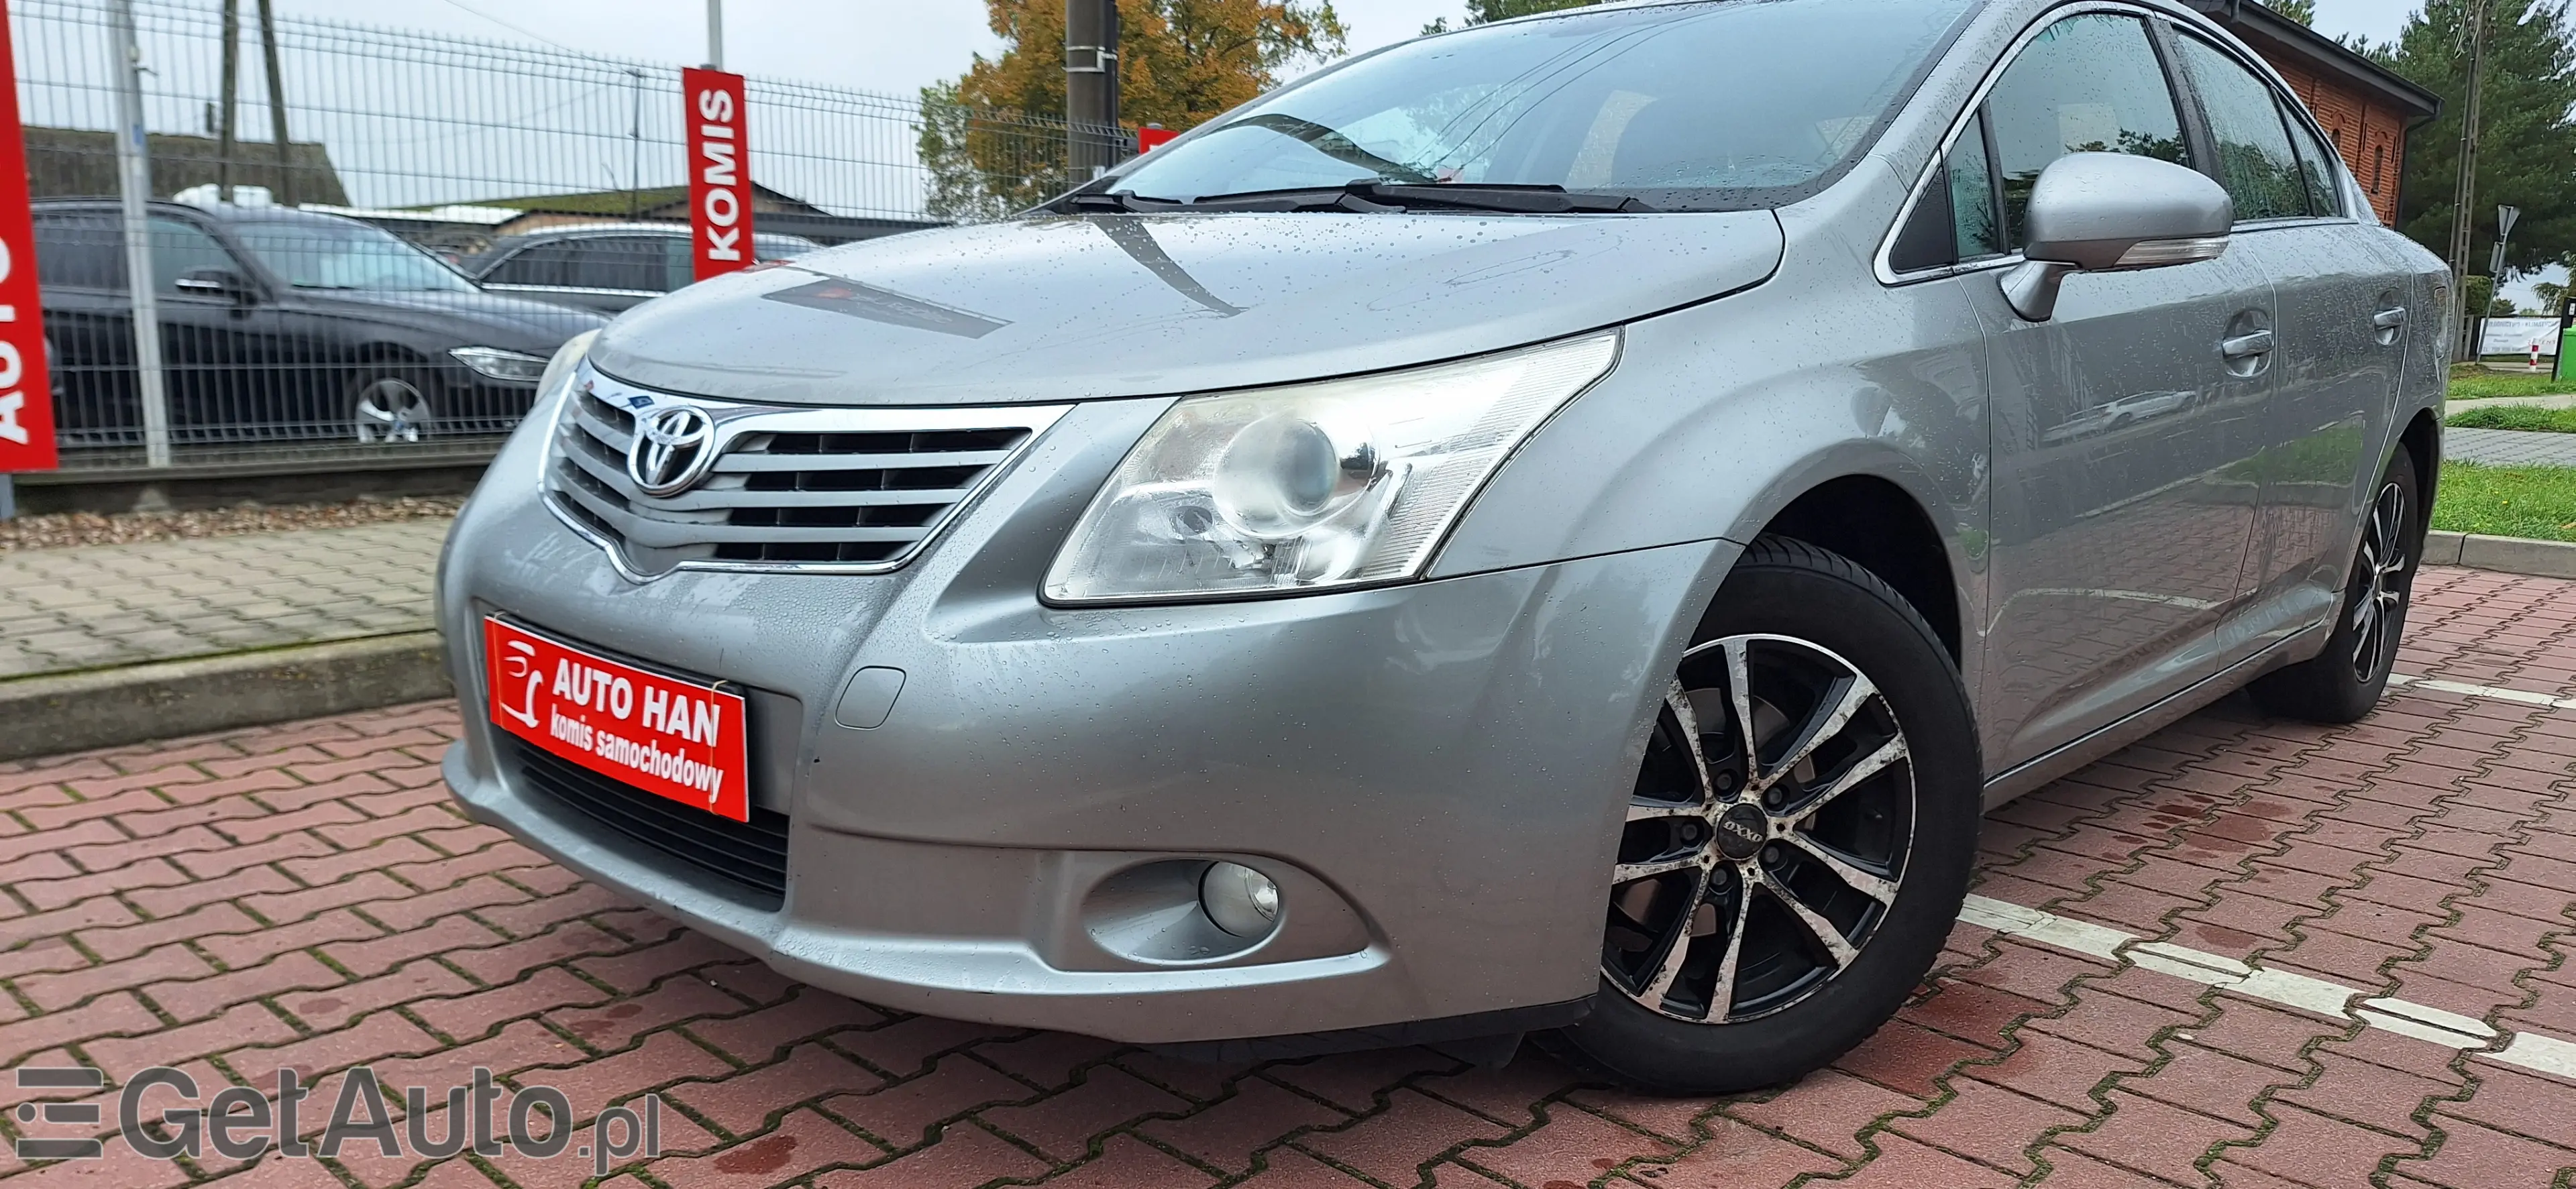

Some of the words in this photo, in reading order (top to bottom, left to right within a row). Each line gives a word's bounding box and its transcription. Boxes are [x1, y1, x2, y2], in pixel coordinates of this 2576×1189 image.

[698, 89, 741, 261] KOMIS
[551, 657, 633, 720] AUTO
[642, 685, 721, 748] HAN
[550, 703, 593, 752] komis
[595, 730, 724, 804] samochodowy
